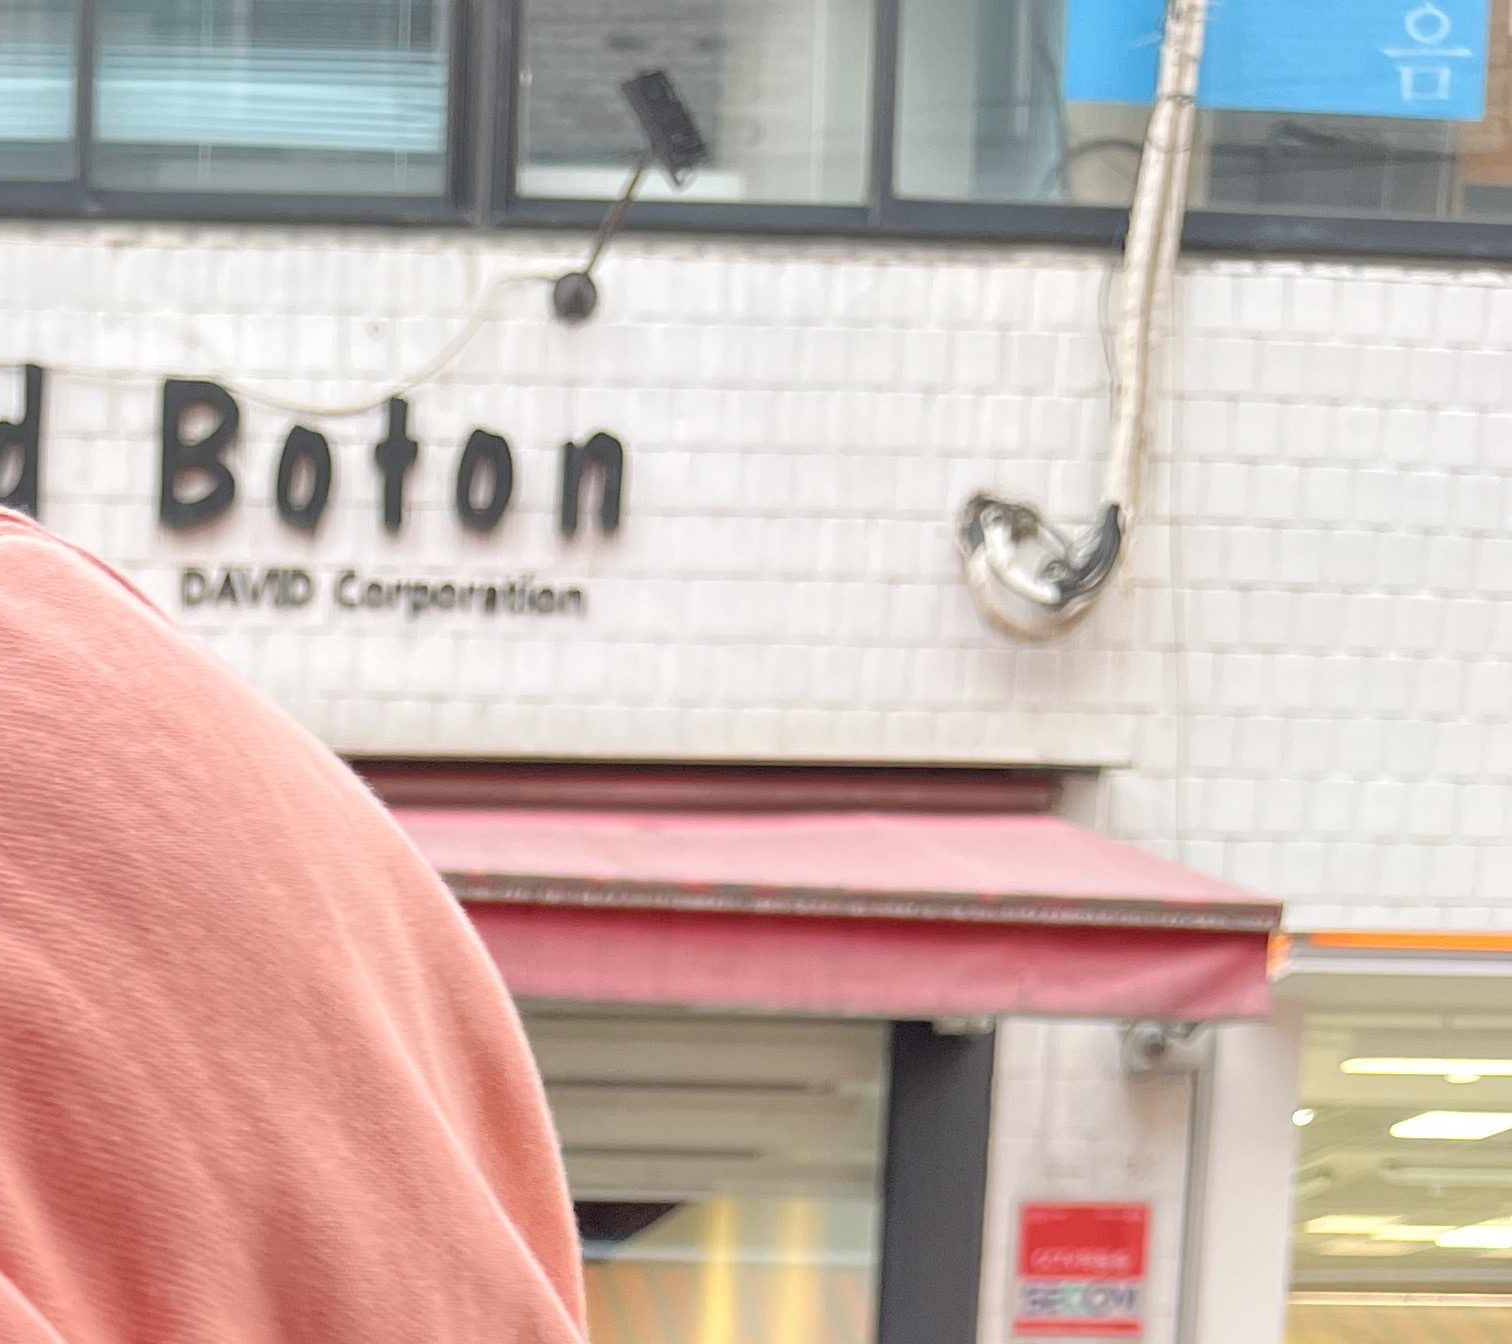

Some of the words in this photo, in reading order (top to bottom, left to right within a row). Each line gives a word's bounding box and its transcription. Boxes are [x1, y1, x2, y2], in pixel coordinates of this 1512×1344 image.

[159, 379, 624, 535] Boton
[181, 567, 315, 608] DAVID
[334, 568, 587, 618] Corporation
